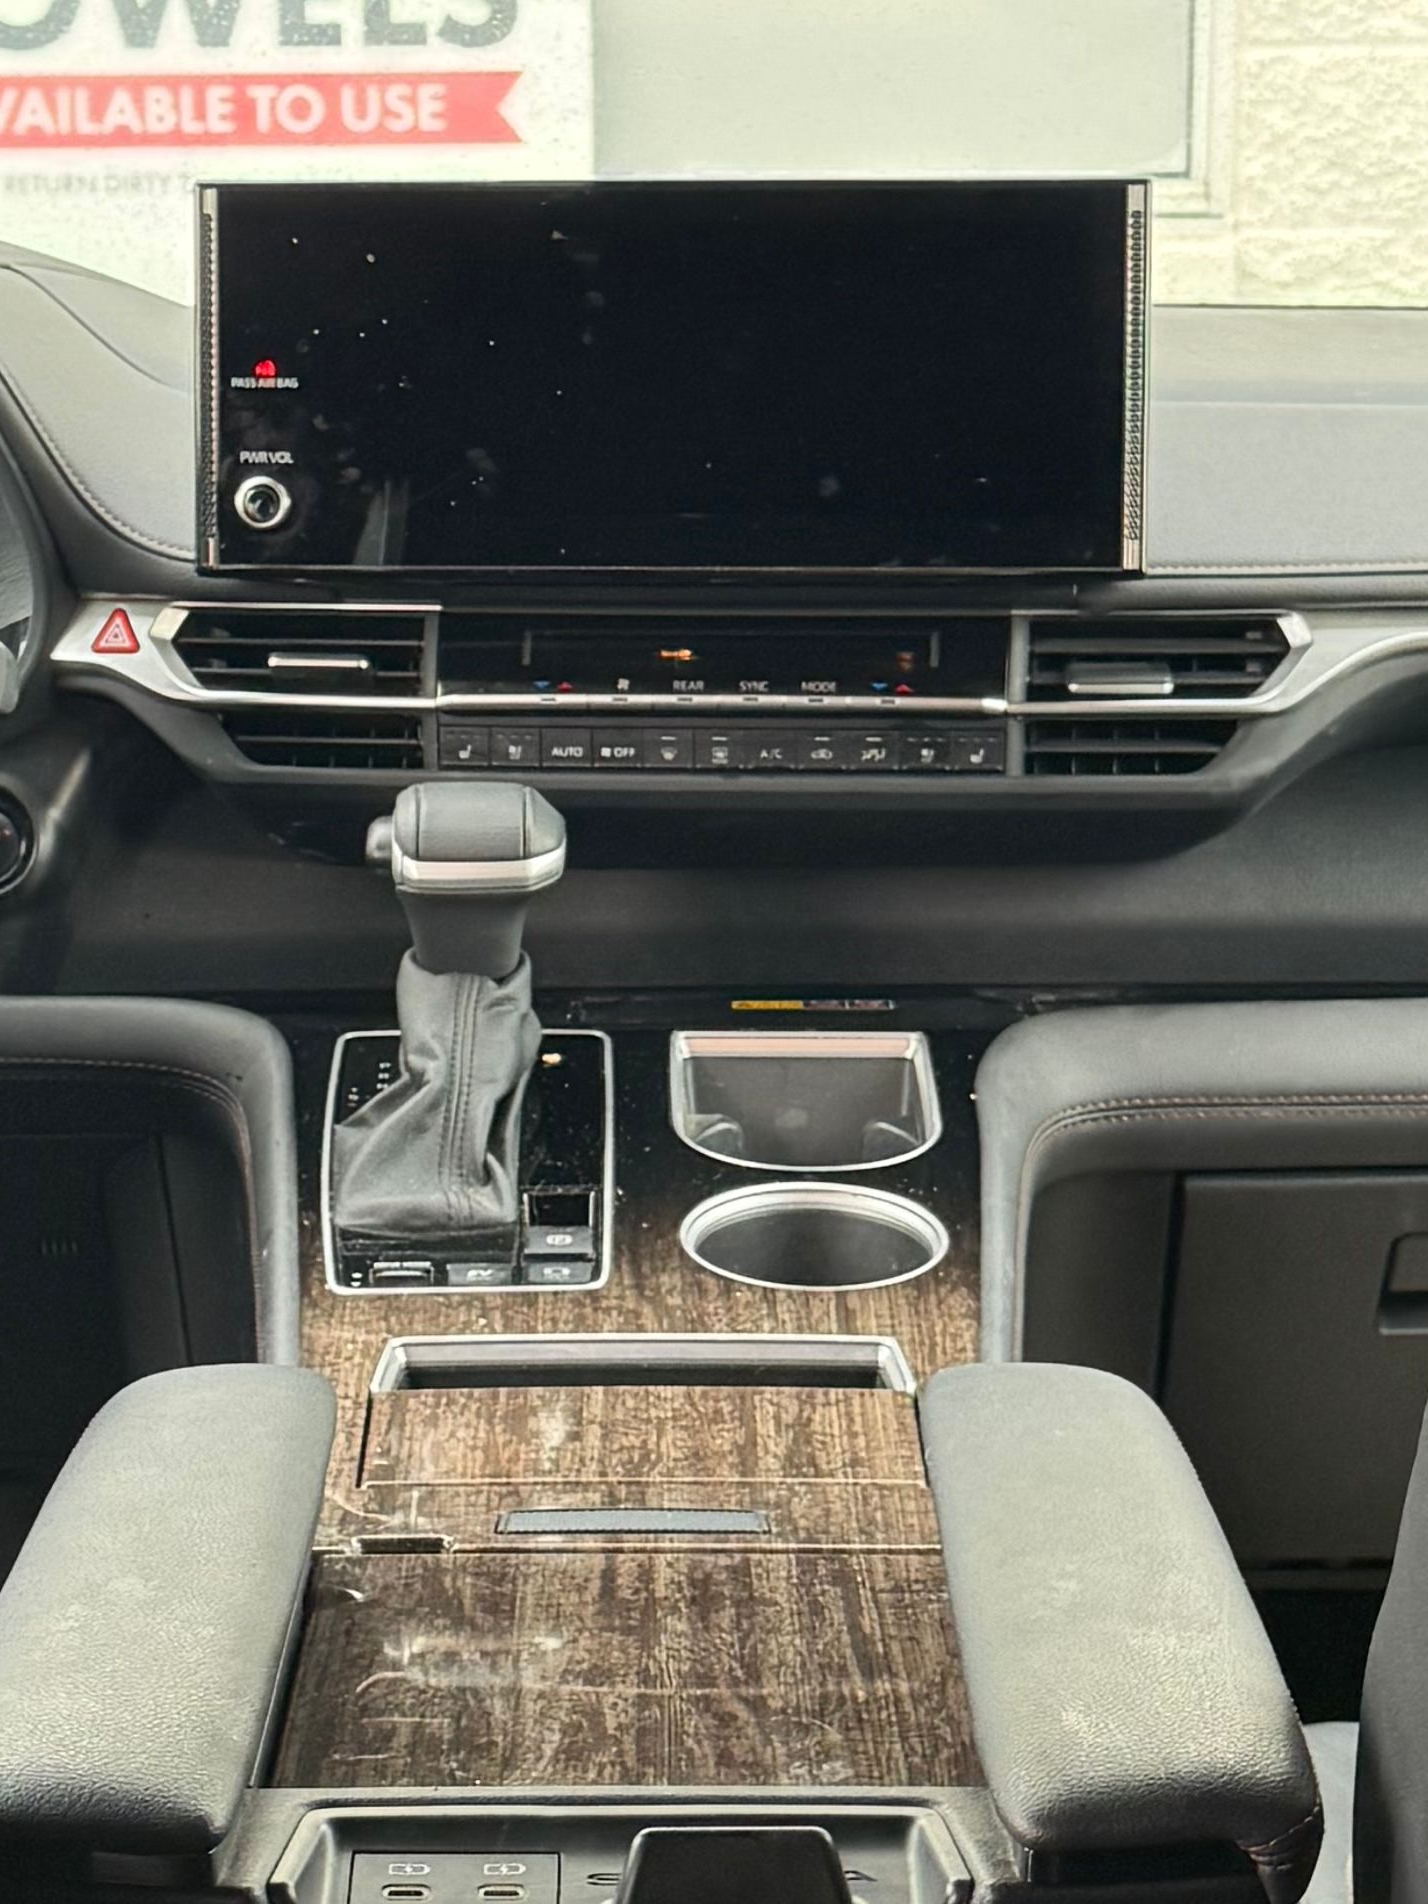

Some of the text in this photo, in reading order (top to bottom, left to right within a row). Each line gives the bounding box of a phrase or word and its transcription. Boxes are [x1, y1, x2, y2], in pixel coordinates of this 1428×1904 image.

[246, 84, 333, 134] TO
[340, 82, 449, 133] USE
[231, 377, 256, 389] PASS
[277, 377, 299, 389] BAG
[239, 450, 295, 464] PWR VOL
[672, 680, 705, 692] REAR
[738, 680, 769, 693] SYNC
[800, 680, 837, 693] MODE
[551, 746, 584, 758] AUTO
[613, 746, 636, 758] OFF
[759, 747, 783, 760] A/C
